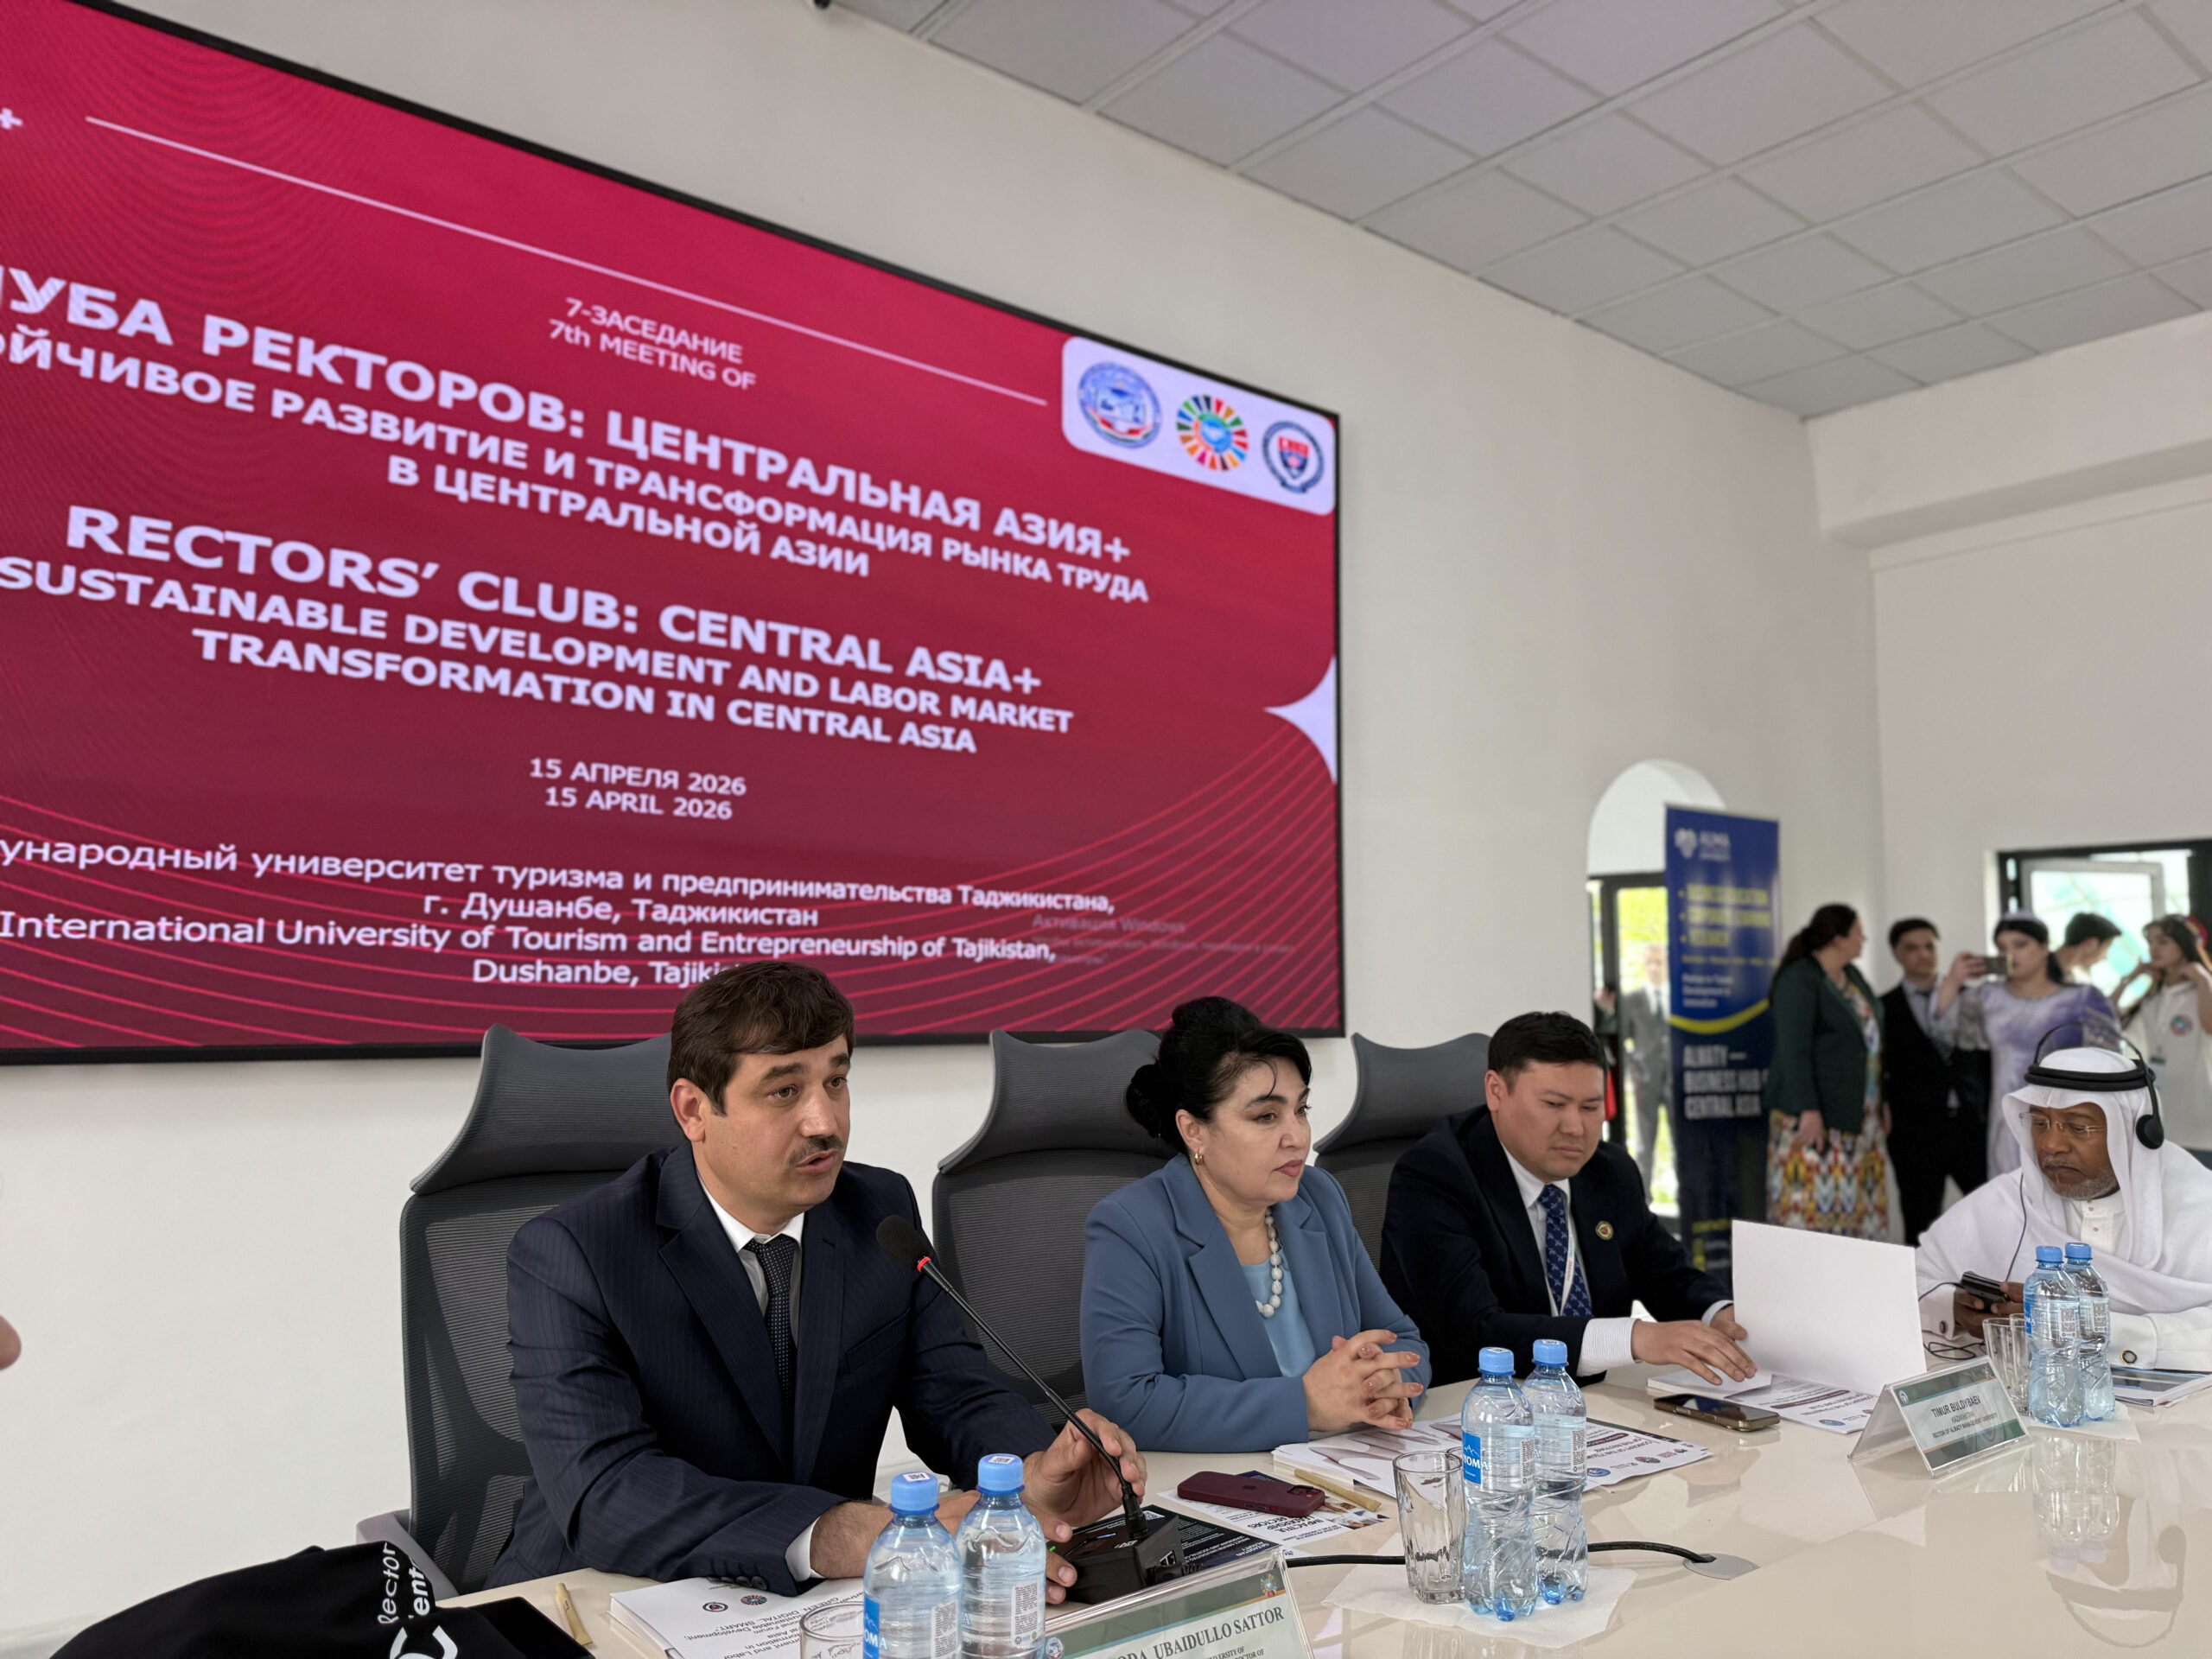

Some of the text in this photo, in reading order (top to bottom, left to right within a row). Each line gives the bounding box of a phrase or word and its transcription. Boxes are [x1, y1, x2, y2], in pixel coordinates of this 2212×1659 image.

[549, 320, 754, 388] 7th MEETING OF
[566, 297, 742, 364] 7-ЗАСЕДАНИЕ
[0, 266, 1129, 562] УБА РЕКТОРОВ: ЦЕНТРАЛЬНАЯ АЗИЯ+
[272, 390, 528, 468] РАЗВИТИЕ
[544, 448, 575, 479] И
[587, 458, 931, 556] ТРАНСФОРМАЦИЯ
[943, 538, 1052, 582] РЫНКА
[1058, 563, 1148, 602] ТРУДА
[389, 455, 868, 576] В ЦЕНТРАЛЬНОЙ АЗИИ
[67, 505, 1040, 694] RECTORS’ CLUB: CENTRAL ASIA+
[0, 557, 1073, 733] SUSTAINABLE DEVELOPMENT AND LABOR MARKET
[193, 629, 976, 753] TRANSFORMATION IN CENTRAL ASIA
[531, 759, 746, 795] 15 АПРЕЛЯ 2026
[547, 787, 732, 819] 15 APRIL 2026
[251, 853, 483, 883] университет
[493, 866, 623, 890] туризма
[634, 874, 652, 890] и
[663, 874, 951, 904] предпринимательства
[957, 885, 1114, 913] Таджикистана,
[424, 893, 817, 928] г. Душанбе, Таджикистан
[0, 912, 264, 943] International
[277, 920, 451, 952] University
[461, 925, 495, 948] of
[505, 926, 626, 950] Tourism
[638, 931, 691, 952] and
[700, 932, 918, 963] Entrepreneurship
[922, 937, 945, 957] of
[952, 938, 1056, 962] Tajikistan,
[474, 959, 639, 987] Dushanbe,
[1931, 1402, 1952, 1418] TIMUR
[1153, 1623, 1232, 1659] UBAIDULLO
[1234, 1606, 1285, 1635] SATTOR
